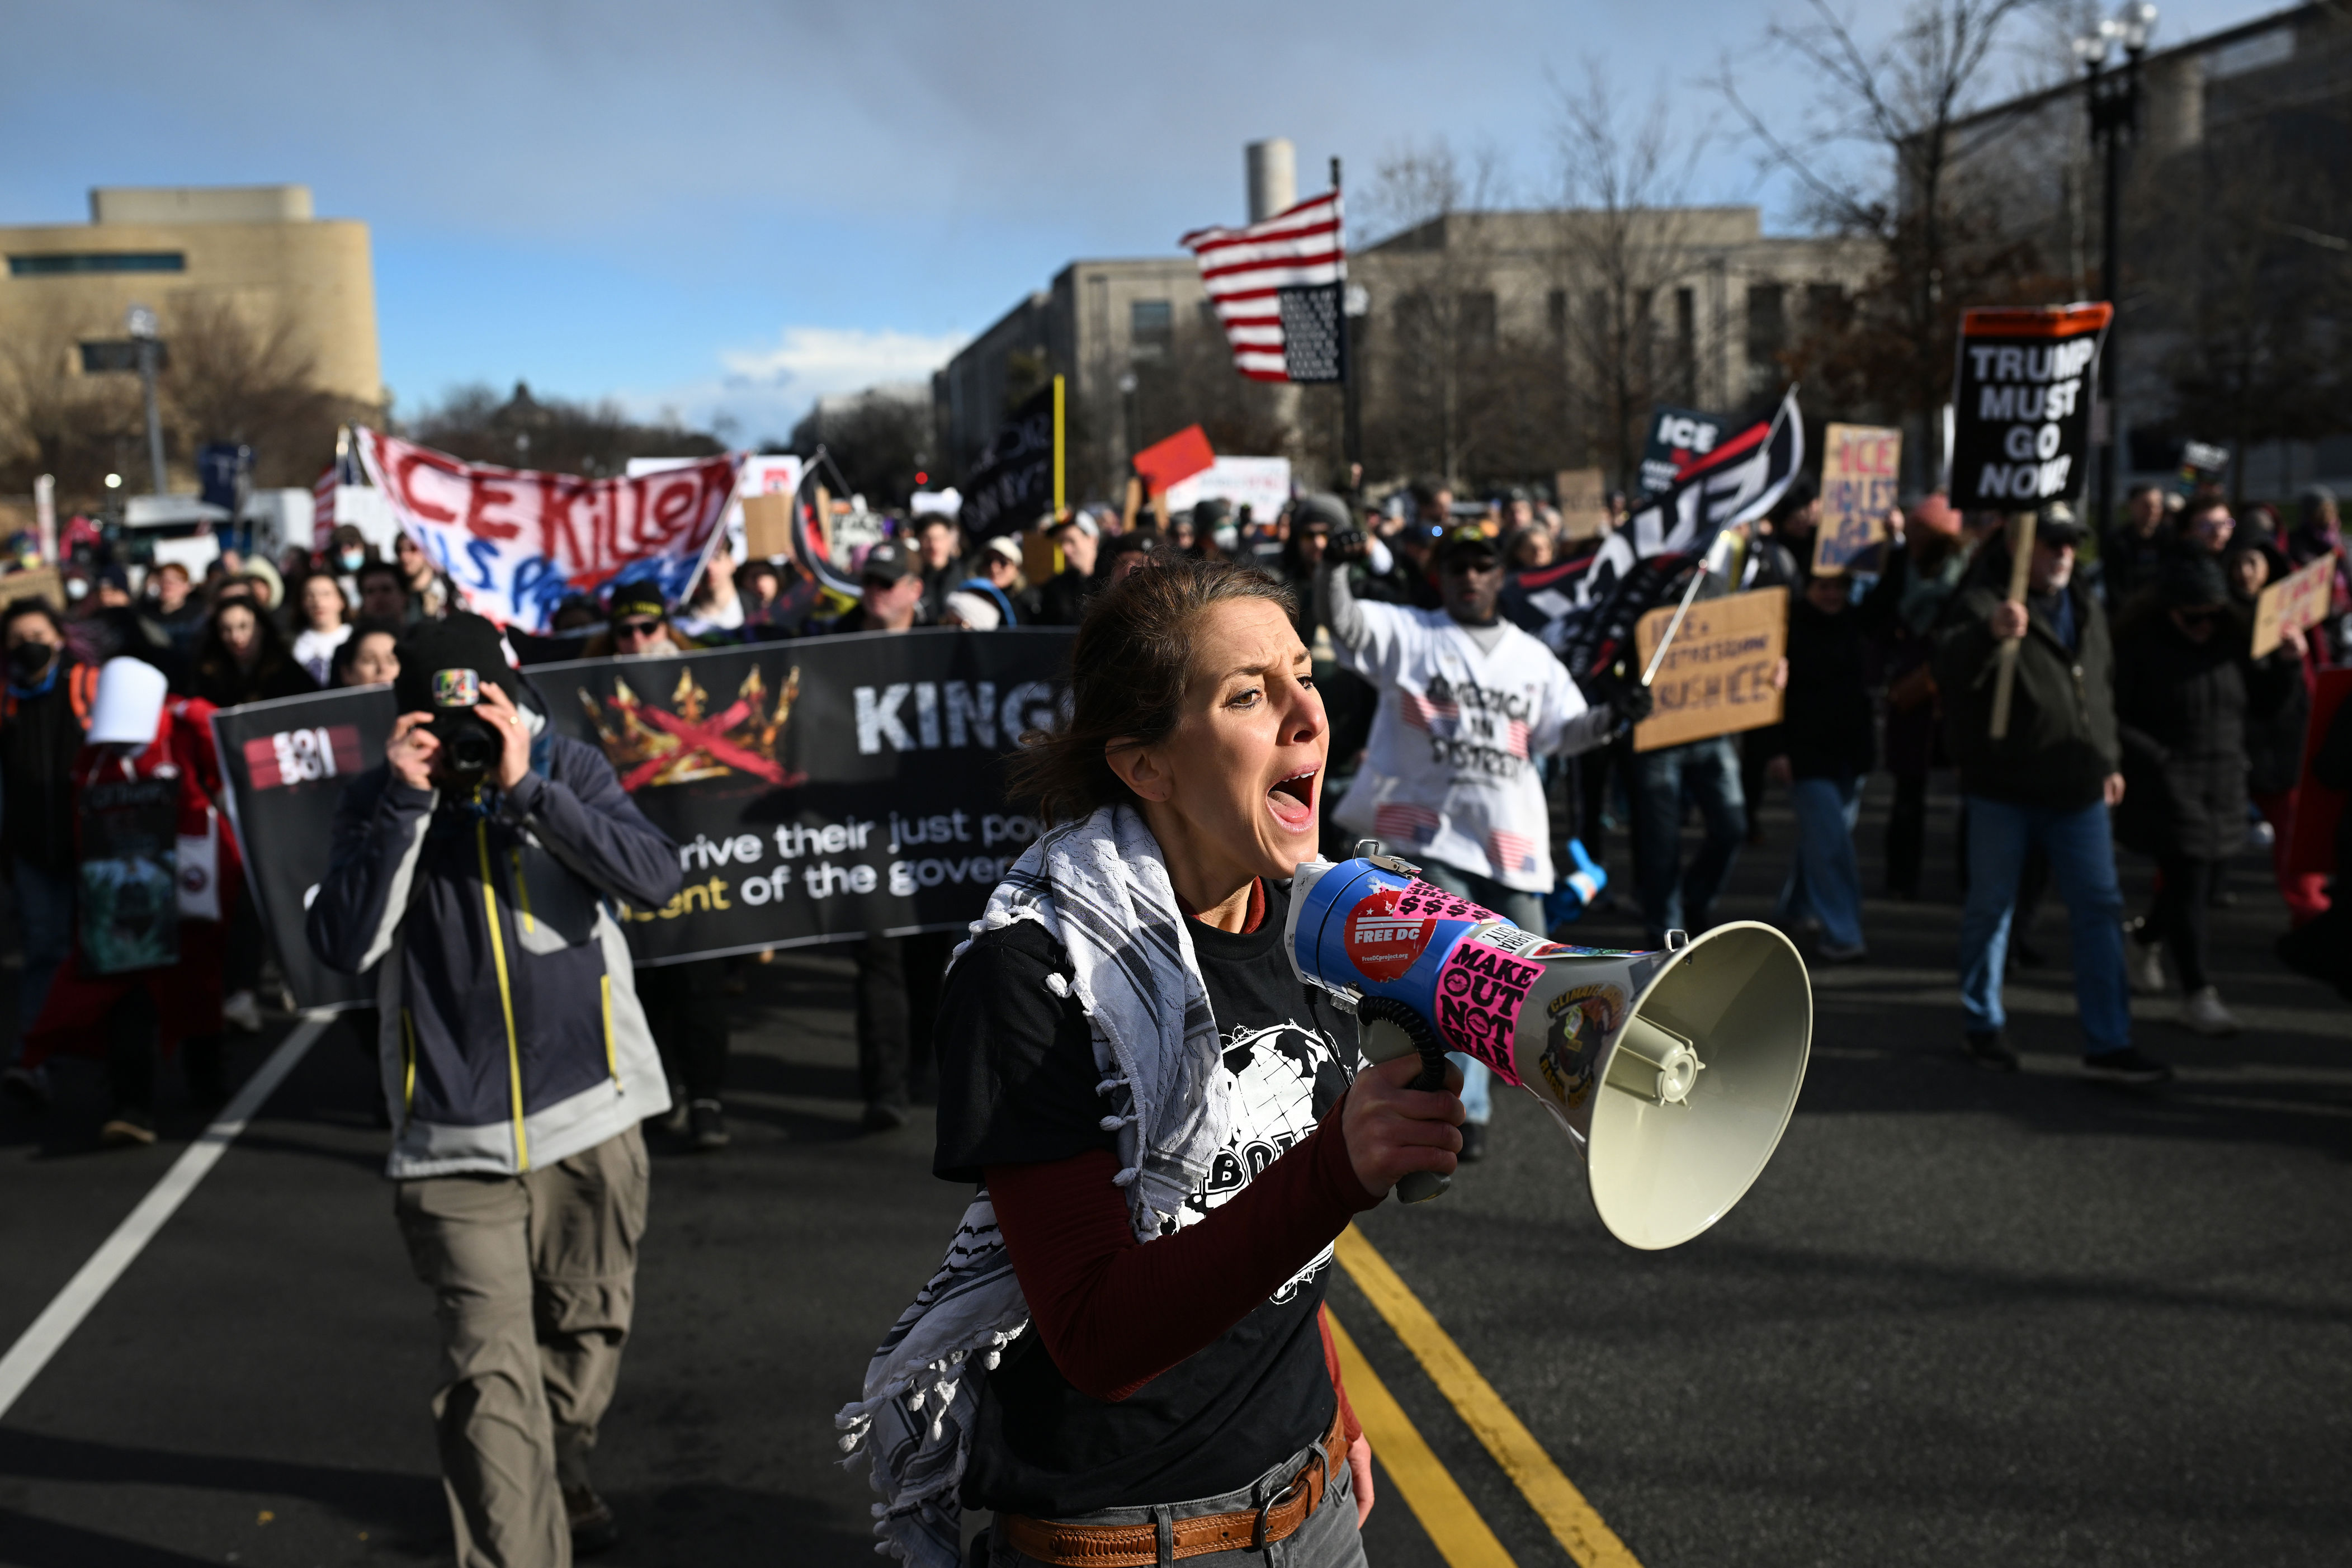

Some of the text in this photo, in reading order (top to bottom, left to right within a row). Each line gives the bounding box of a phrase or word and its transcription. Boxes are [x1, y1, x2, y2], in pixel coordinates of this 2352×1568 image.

[1968, 337, 2095, 381] TRUMP
[1979, 377, 2081, 421] MUST
[1656, 414, 1718, 454] ICE
[1840, 436, 1895, 476] ICE
[2004, 422, 2061, 461] GO
[1977, 454, 2071, 499] NOW!
[679, 833, 763, 872] rive
[773, 815, 875, 859] their
[886, 808, 971, 854] just
[740, 865, 791, 906] of
[803, 861, 878, 899] the
[888, 855, 1013, 897] gover
[1354, 928, 1420, 944] FREE DC
[1362, 953, 1408, 962] FreeDCproject.org
[1452, 943, 1538, 989] MAKE
[1444, 968, 1524, 1017] OUT
[1440, 994, 1513, 1049] NOT
